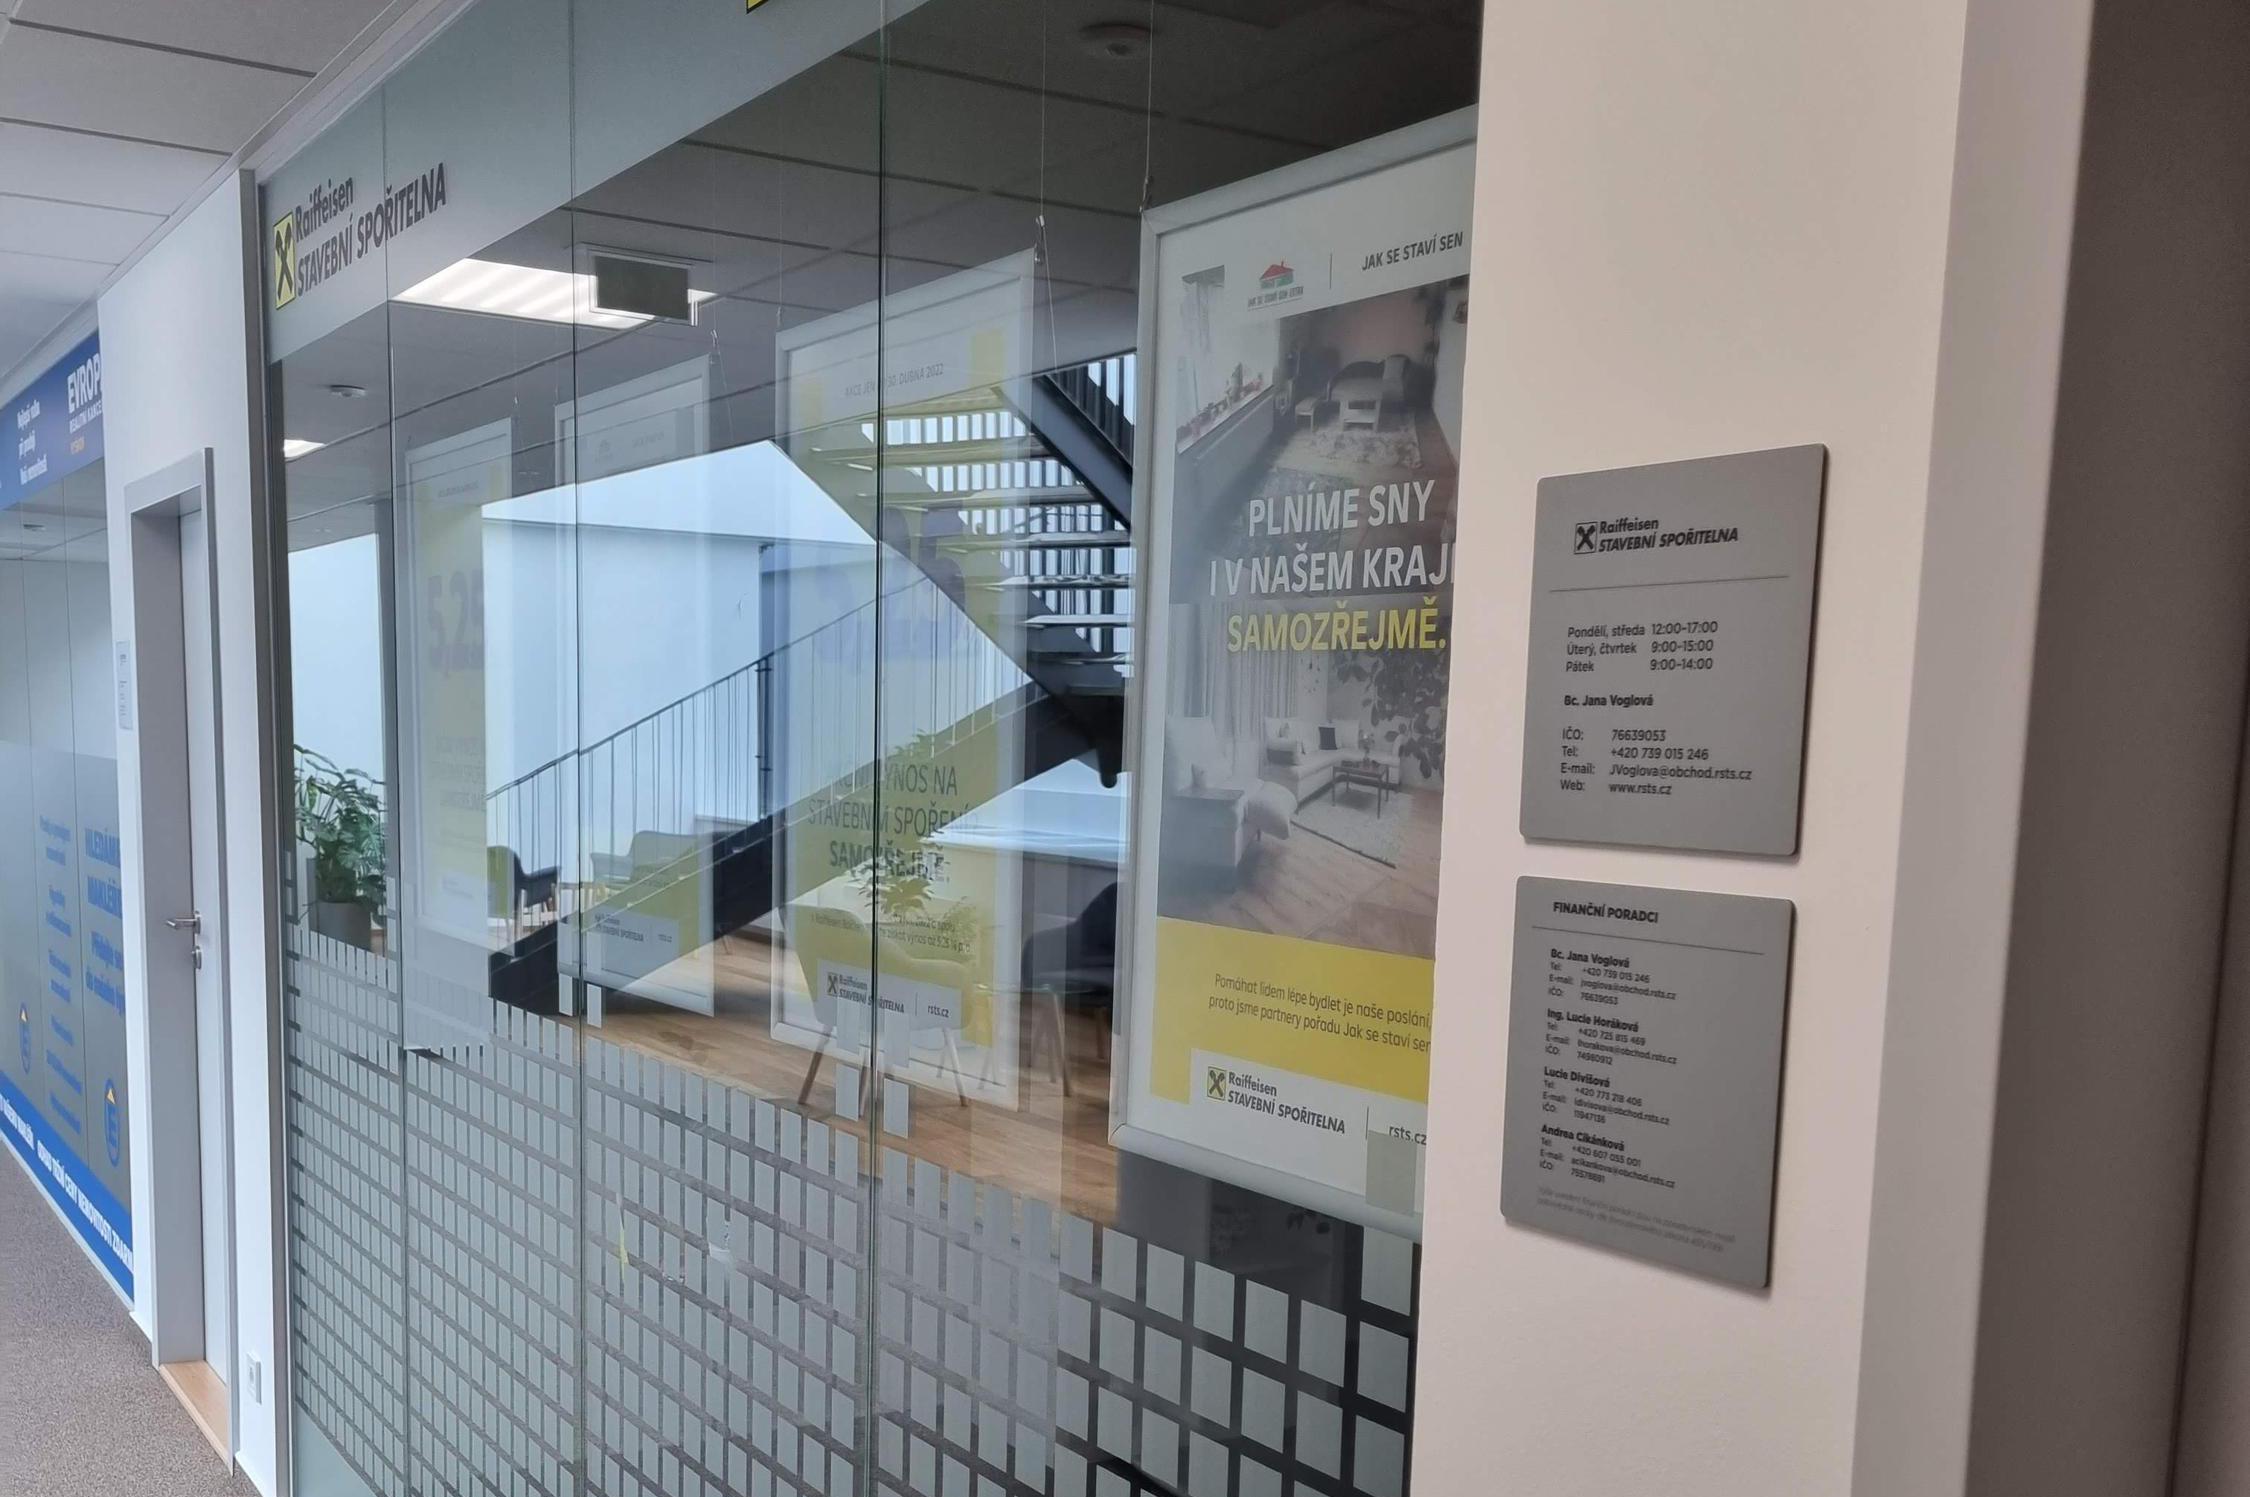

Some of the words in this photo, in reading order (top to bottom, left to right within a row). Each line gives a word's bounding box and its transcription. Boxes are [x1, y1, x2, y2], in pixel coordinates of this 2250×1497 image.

[296, 177, 354, 243] Raiffeisen
[297, 213, 354, 297] STAVEBNÍ
[357, 162, 446, 259] SPOŘITELNA
[1362, 252, 1383, 271] JAK
[1386, 248, 1400, 265] SE
[1403, 233, 1437, 261] STAVÍ
[1439, 231, 1464, 252] SEN
[67, 352, 102, 414] EVROP
[1250, 481, 1360, 537] PLNÍME
[1367, 479, 1435, 527] SNY
[1600, 517, 1659, 533] Raiffeisen
[1599, 531, 1656, 552] STAVEBNÍ
[1659, 527, 1739, 548] SPOŘITELNA
[1210, 560, 1217, 596] I
[1225, 558, 1244, 596] V
[1250, 542, 1354, 594] NAŠEM
[1227, 595, 1447, 653] SAMOZŘEJMĚ.
[1568, 624, 1608, 639] Pondělí,
[1611, 623, 1646, 637] středa
[1567, 641, 1597, 657] Úterý,
[1600, 641, 1637, 655] čtvrtek
[1566, 660, 1595, 672] Pátek
[1564, 695, 1579, 706] Bc.
[1582, 695, 1607, 706] Jana
[1609, 693, 1654, 708] Voglová
[1562, 726, 1584, 741] IČO:
[1612, 729, 1667, 742] 76639053
[1611, 747, 1638, 759] +420
[1641, 747, 1661, 759] 739
[1665, 748, 1684, 760] 015
[1687, 749, 1709, 760] 246
[934, 765, 958, 796] NA
[1560, 762, 1595, 775] E-mail:
[1560, 779, 1585, 791] Web:
[1609, 782, 1672, 795] www.rsts.cz
[1553, 901, 1606, 917] FINANČNÍ
[1607, 907, 1659, 923] PORADCI
[1551, 948, 1565, 959] Bc.
[1567, 950, 1588, 963] Jana
[1591, 952, 1630, 968] Voglová
[1215, 972, 1258, 994] Pomáhat
[1260, 979, 1285, 1000] lidem
[1287, 986, 1307, 1006] lépe
[1309, 991, 1341, 1014] bydlet
[1343, 997, 1354, 1017] je
[1356, 1000, 1384, 1020] naše
[927, 1004, 950, 1018] rsts.cz
[1208, 994, 1235, 1012] proto
[1236, 998, 1259, 1018] jsme
[1260, 1003, 1302, 1030] partnery
[1303, 1013, 1341, 1036] pořadu
[1342, 1021, 1363, 1041] Jak
[1366, 1026, 1379, 1042] se
[1381, 1030, 1410, 1049] staví
[1547, 1008, 1564, 1021] Ing.
[1566, 1011, 1591, 1025] Lucie
[1593, 1016, 1639, 1032] Horáková
[1228, 1071, 1278, 1097] Raiffeisen
[1544, 1066, 1568, 1080] Lucie
[1570, 1070, 1610, 1088] Divišová
[1227, 1090, 1276, 1115] STAVEBNÍ
[1278, 1103, 1346, 1134] SPOŘITELNA
[1389, 1124, 1428, 1146] rsts.cz
[1541, 1124, 1575, 1141] Andrea
[1576, 1130, 1625, 1151] Cikánková
